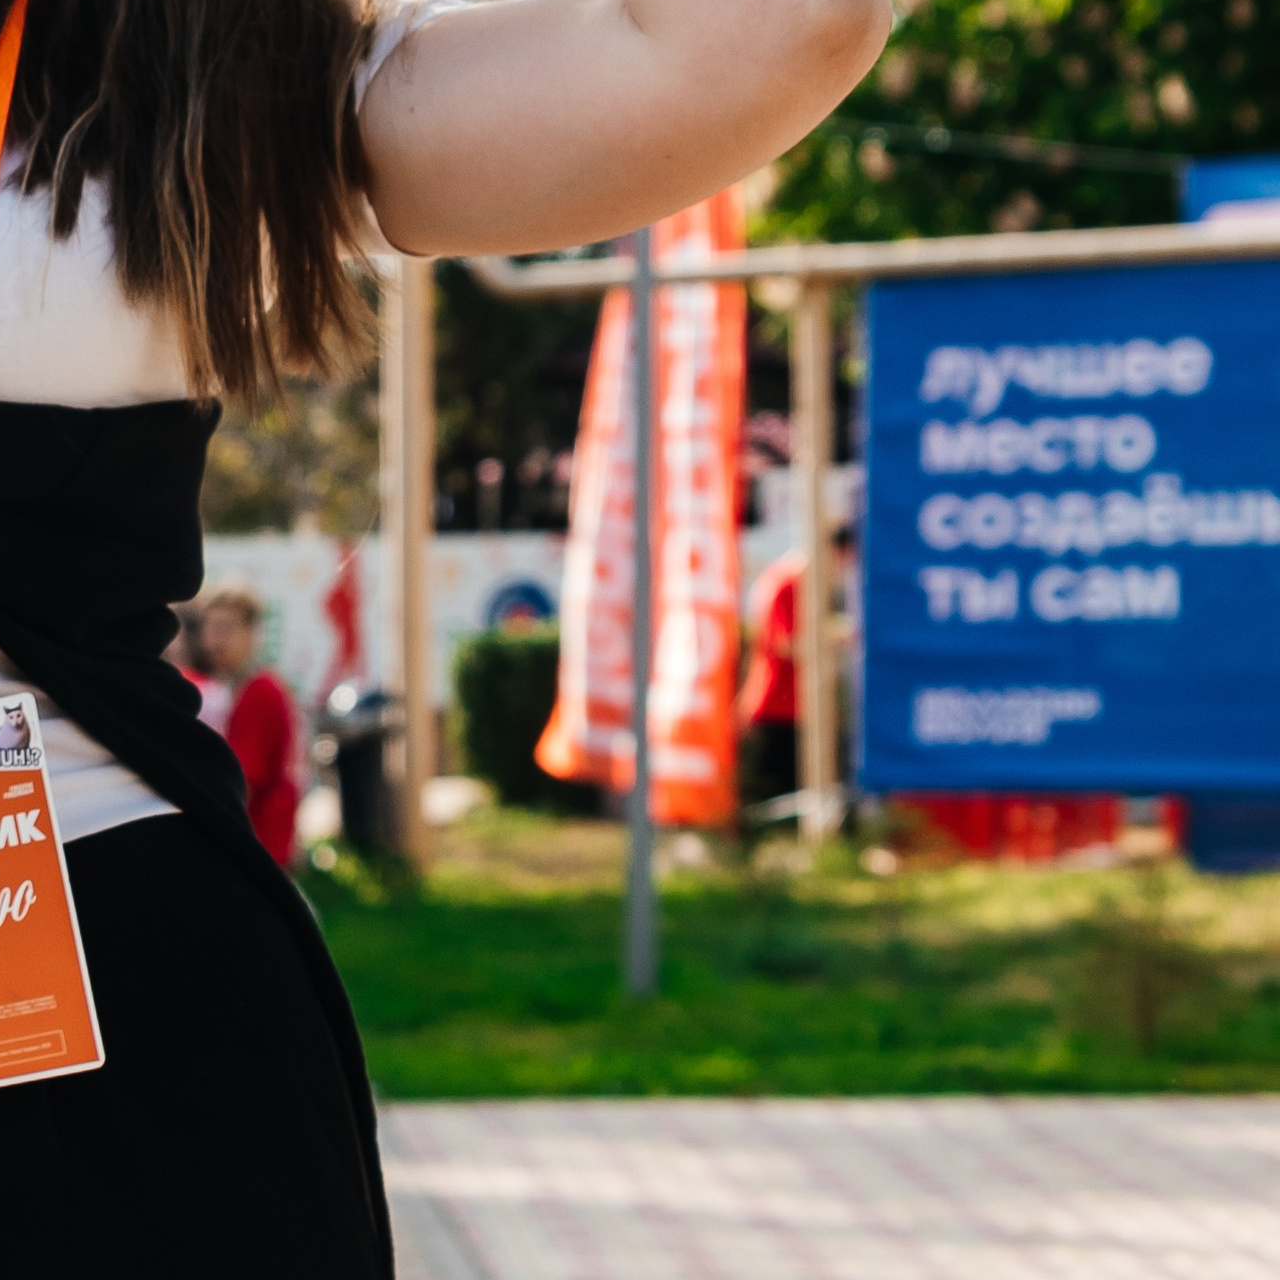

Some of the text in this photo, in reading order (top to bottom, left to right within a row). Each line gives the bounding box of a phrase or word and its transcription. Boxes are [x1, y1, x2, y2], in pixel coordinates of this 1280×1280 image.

[920, 415, 1157, 473] место
[917, 564, 1181, 622] ты сам
